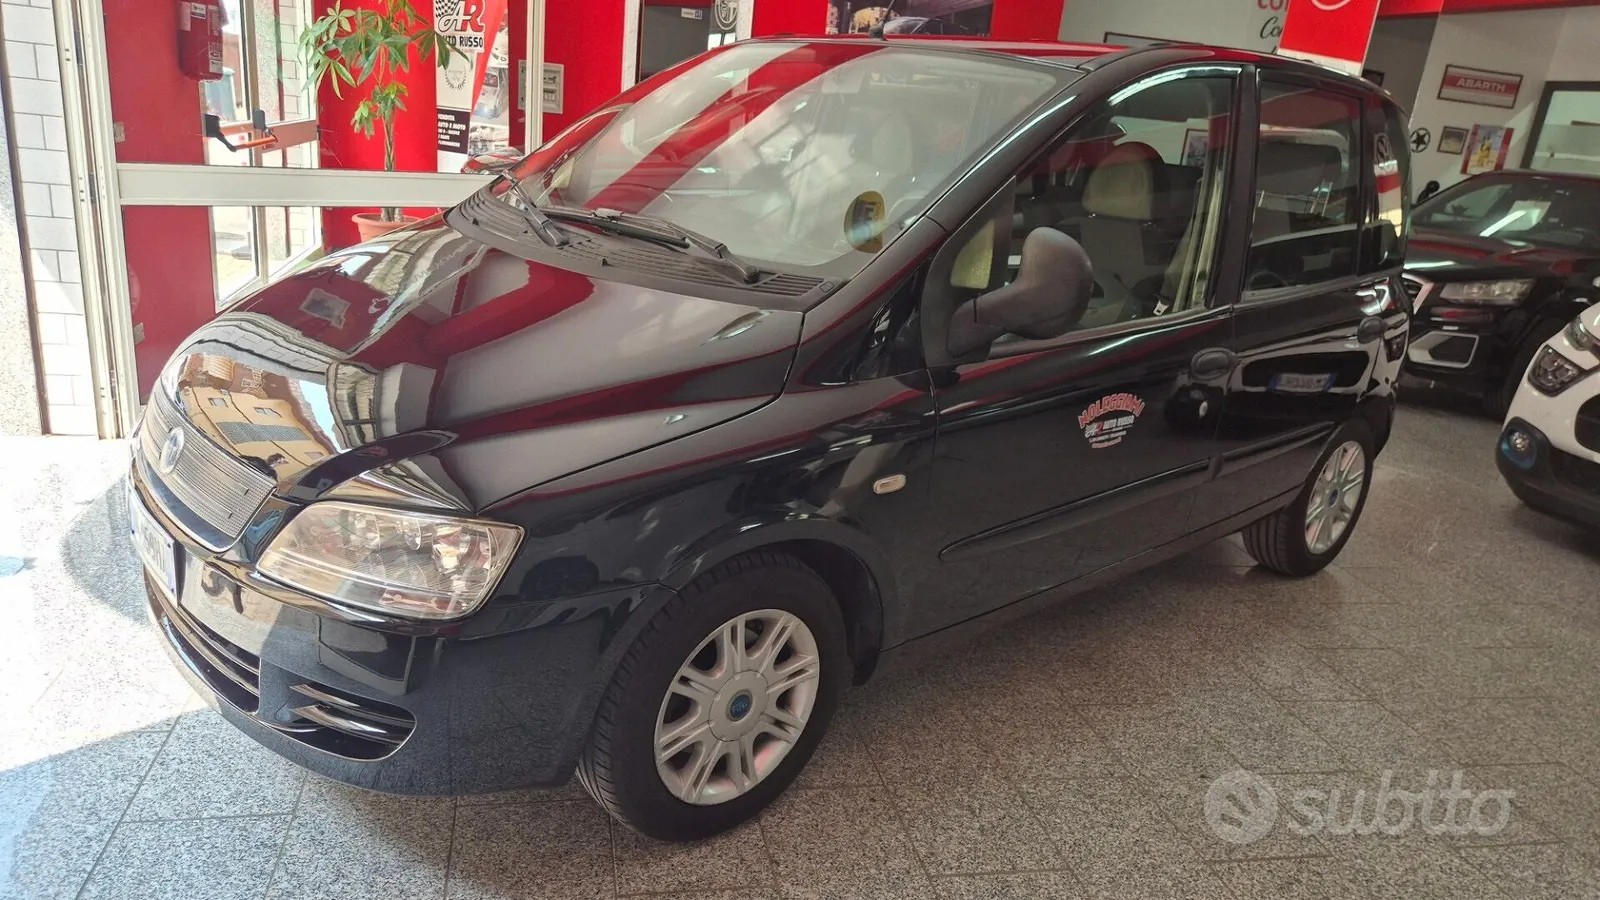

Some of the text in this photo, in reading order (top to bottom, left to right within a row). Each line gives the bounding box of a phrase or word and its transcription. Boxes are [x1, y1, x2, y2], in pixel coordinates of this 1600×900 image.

[459, 36, 484, 48] RUSSO
[1456, 78, 1507, 93] ABARTH
[1077, 392, 1146, 430] NOLEGGIAMI
